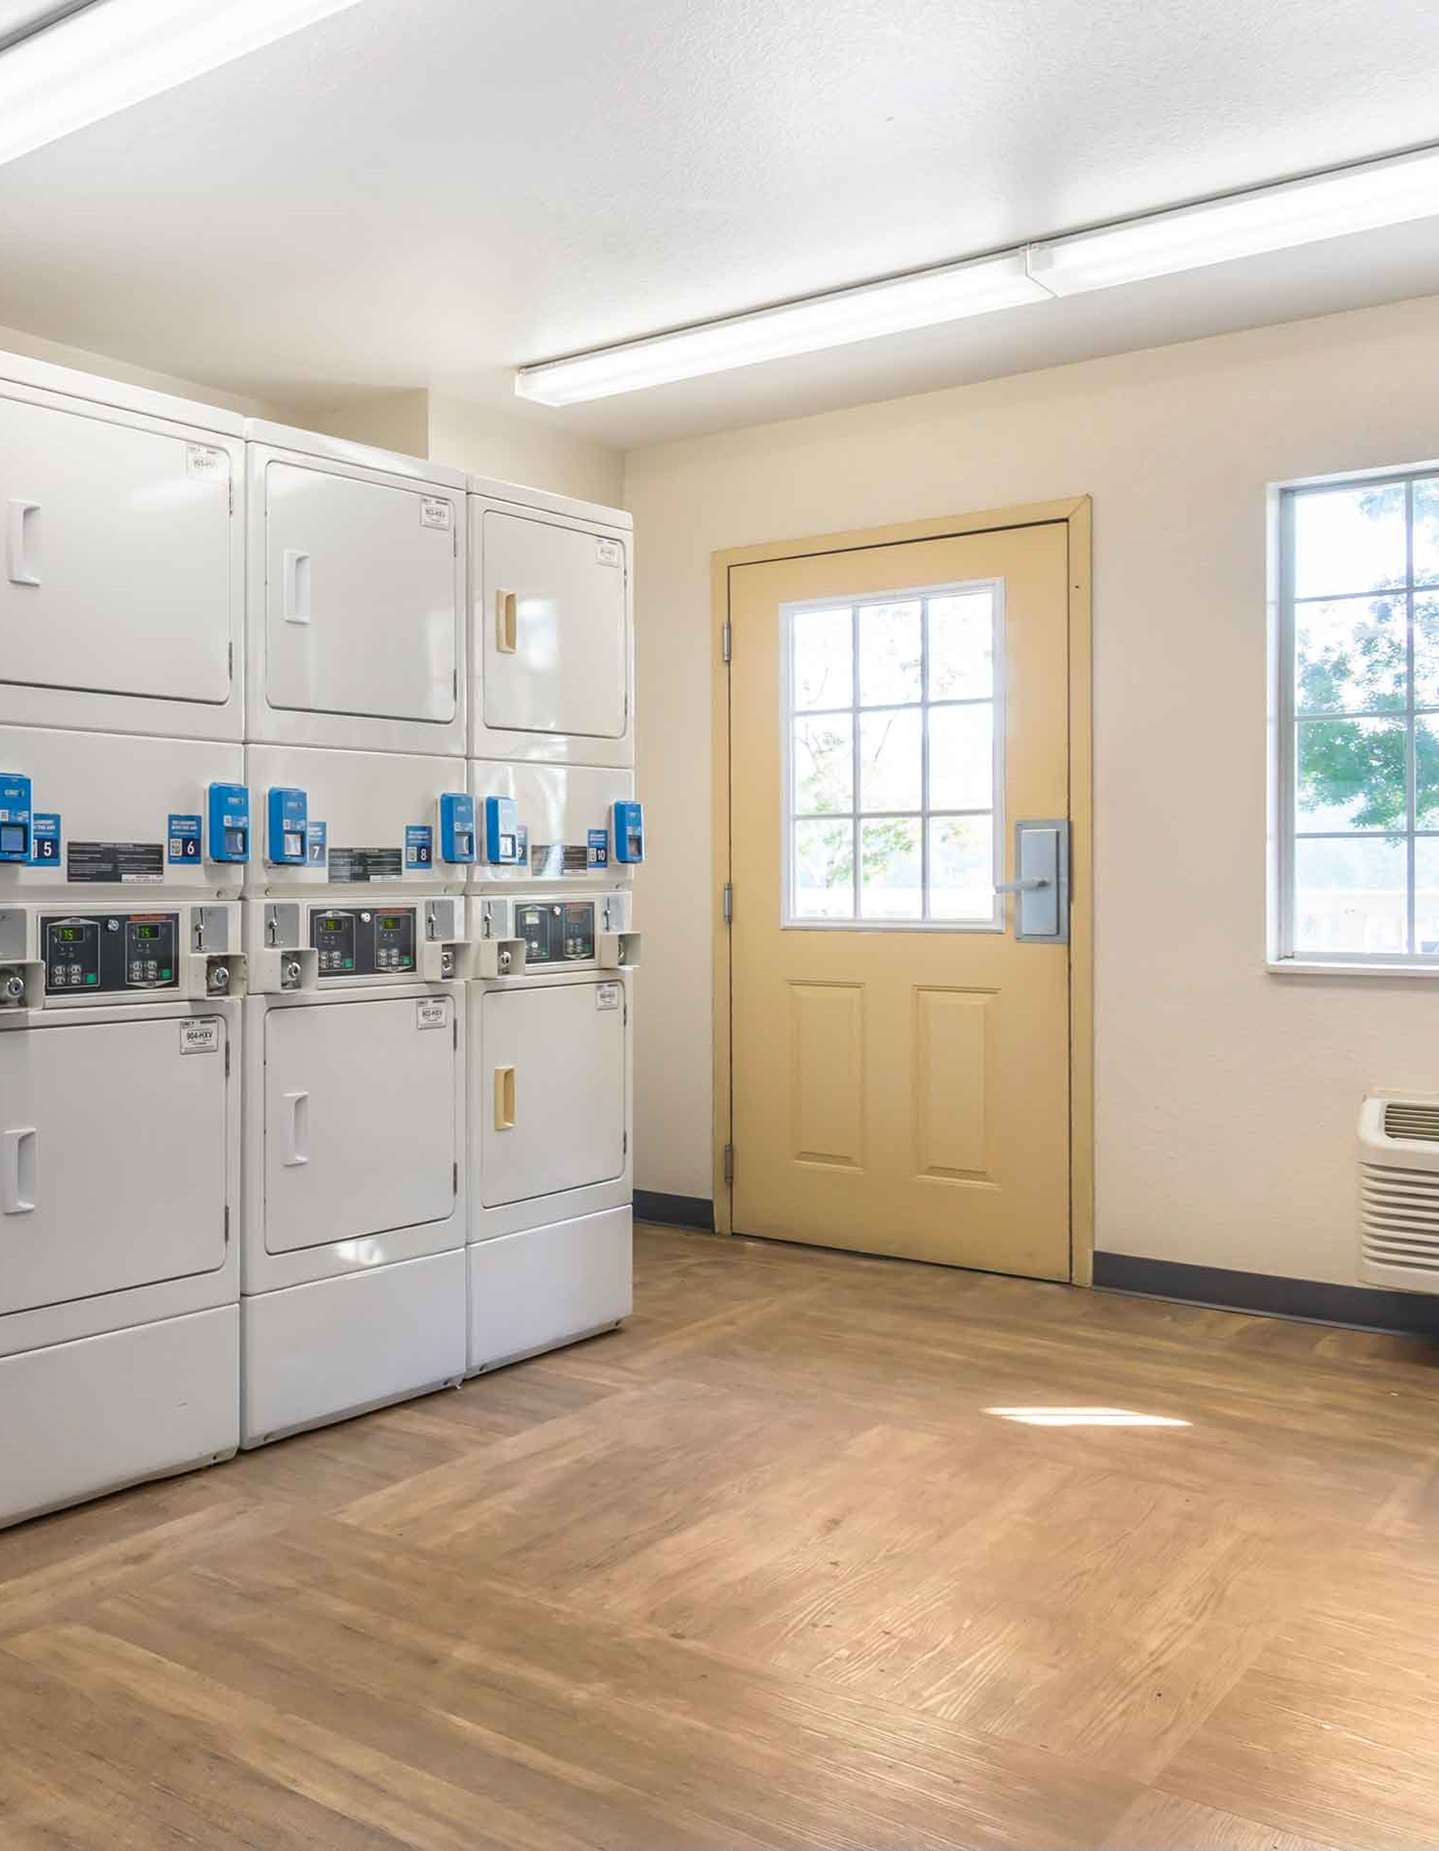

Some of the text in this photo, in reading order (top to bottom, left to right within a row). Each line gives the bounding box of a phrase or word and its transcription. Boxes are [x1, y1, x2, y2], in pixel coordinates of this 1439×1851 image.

[43, 841, 52, 857] 5
[187, 841, 195, 855] 6
[312, 845, 320, 859] 7
[420, 848, 427, 861] 8
[597, 849, 606, 861] 10
